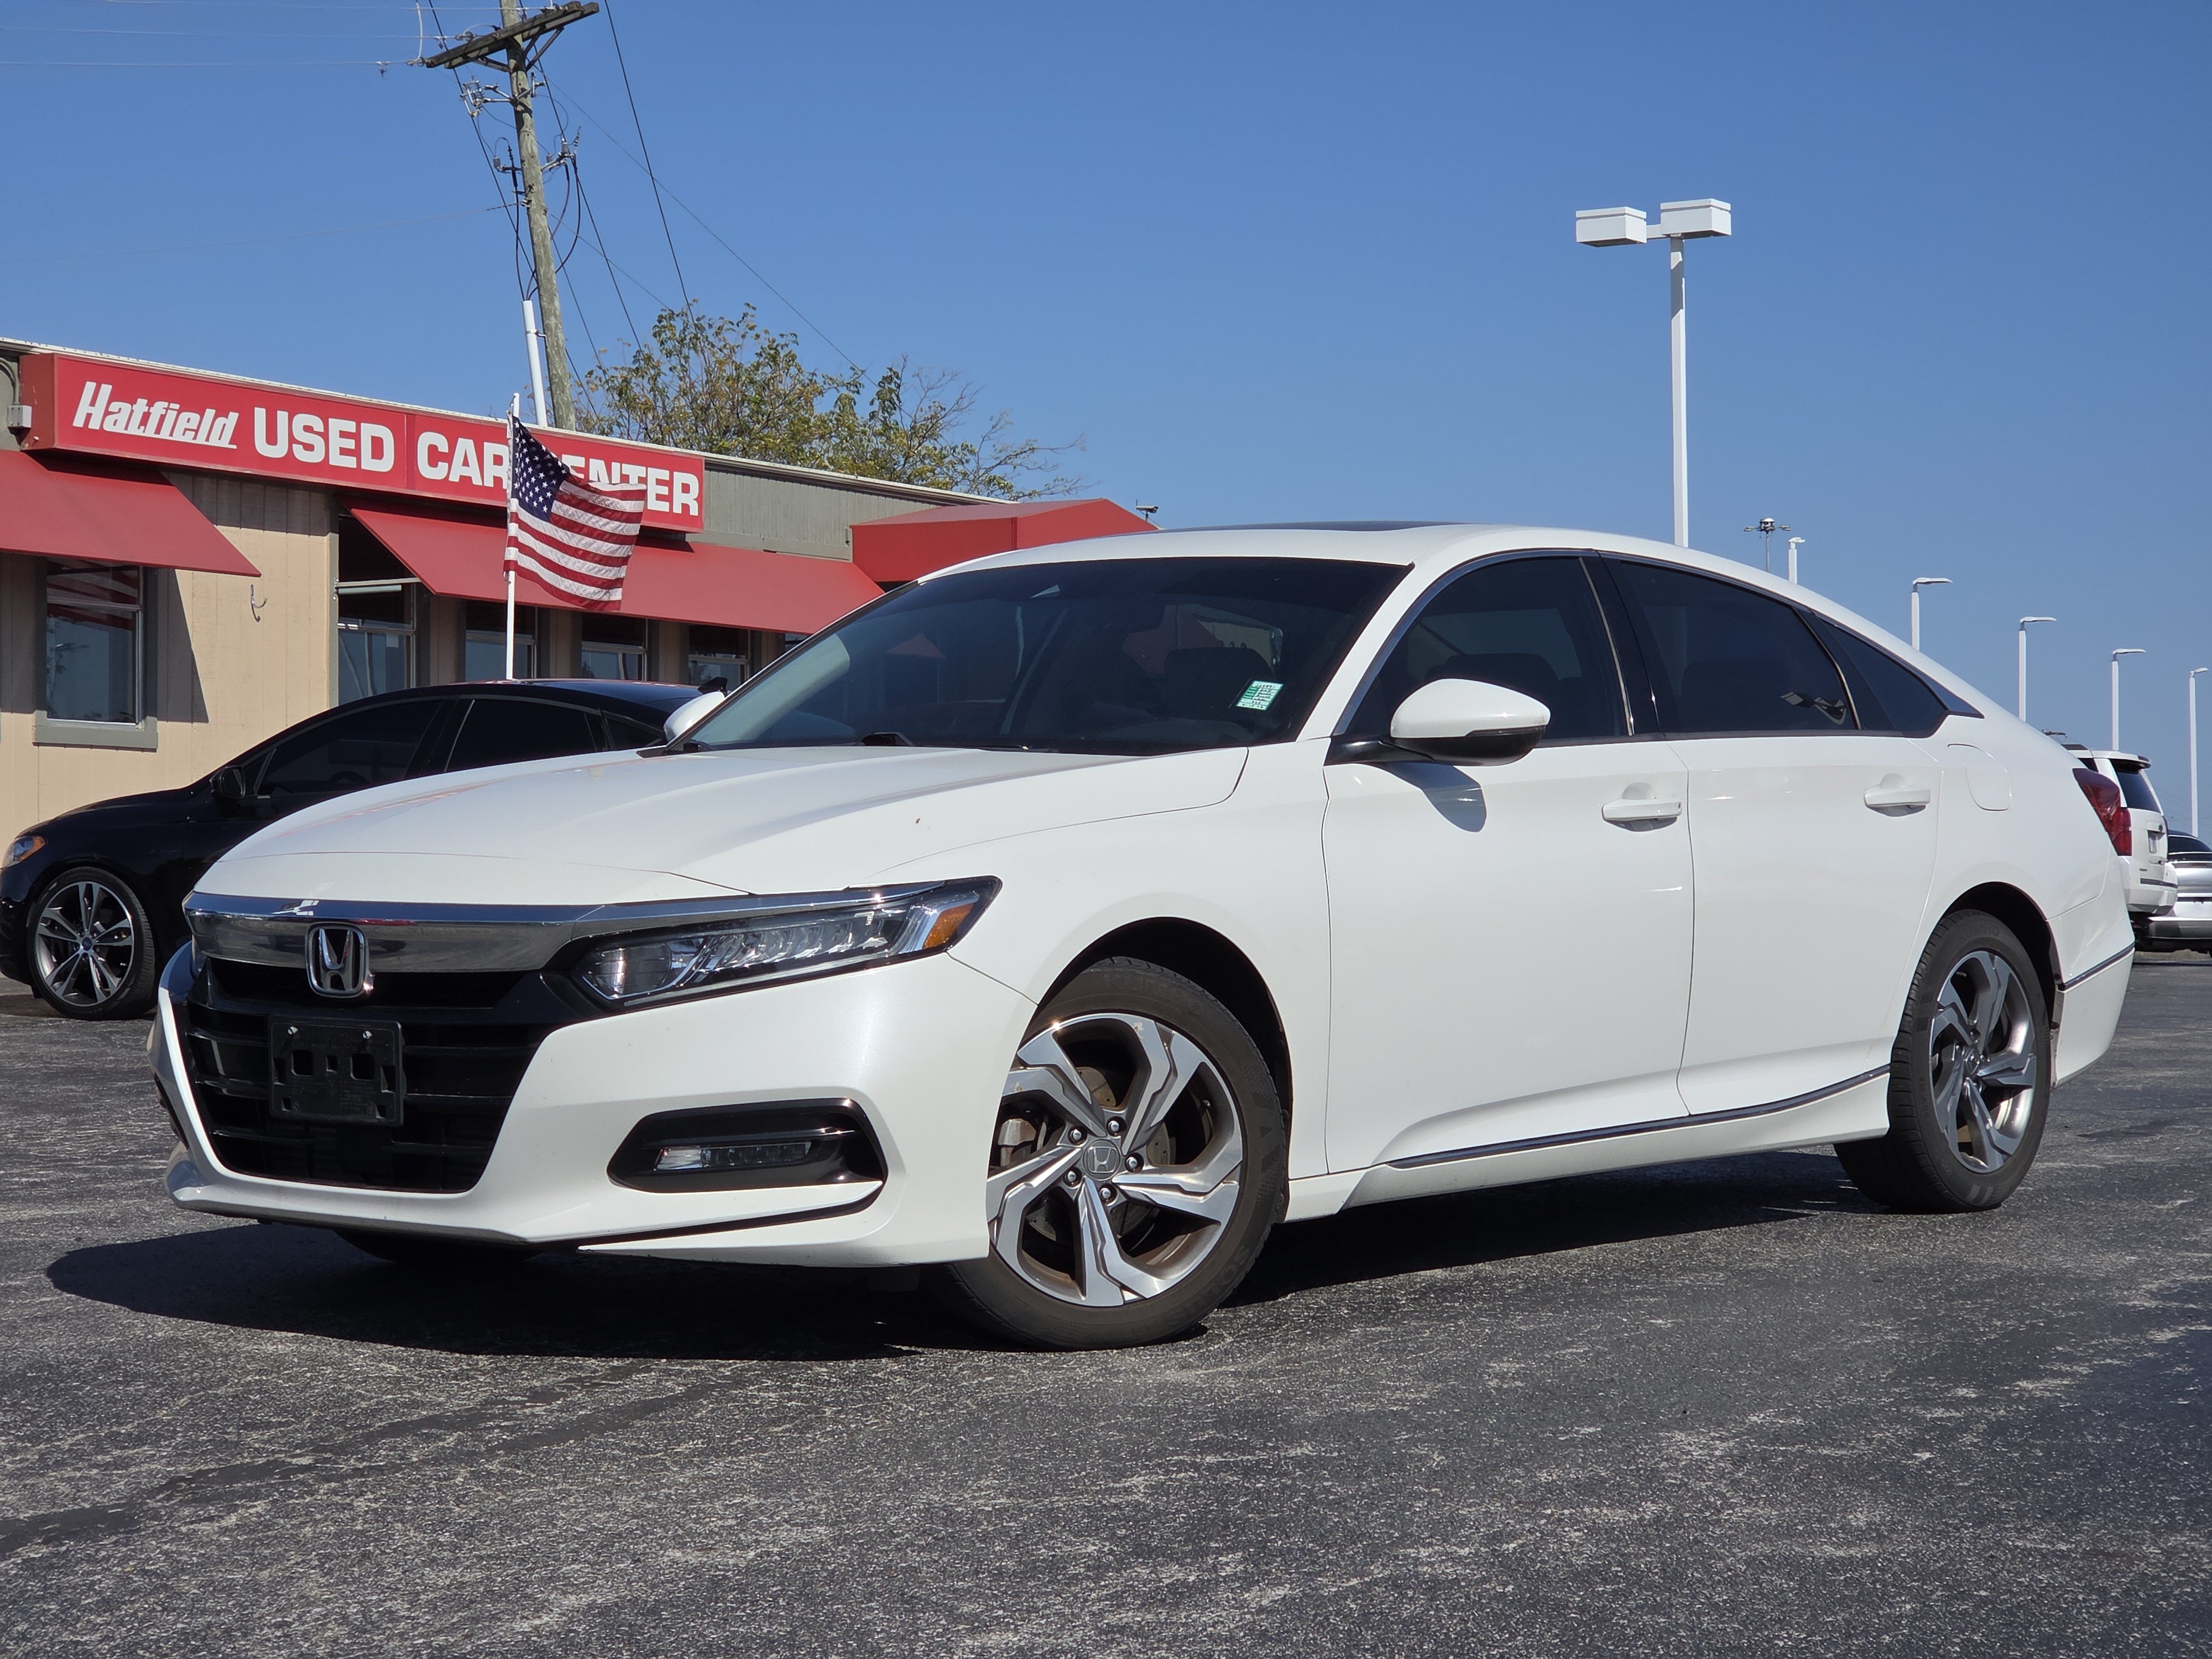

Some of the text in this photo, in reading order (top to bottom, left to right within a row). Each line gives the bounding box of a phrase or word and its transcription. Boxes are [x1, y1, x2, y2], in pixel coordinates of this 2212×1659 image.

[72, 381, 239, 449] Hatfield
[254, 406, 395, 472] USED
[416, 431, 509, 490] CAR
